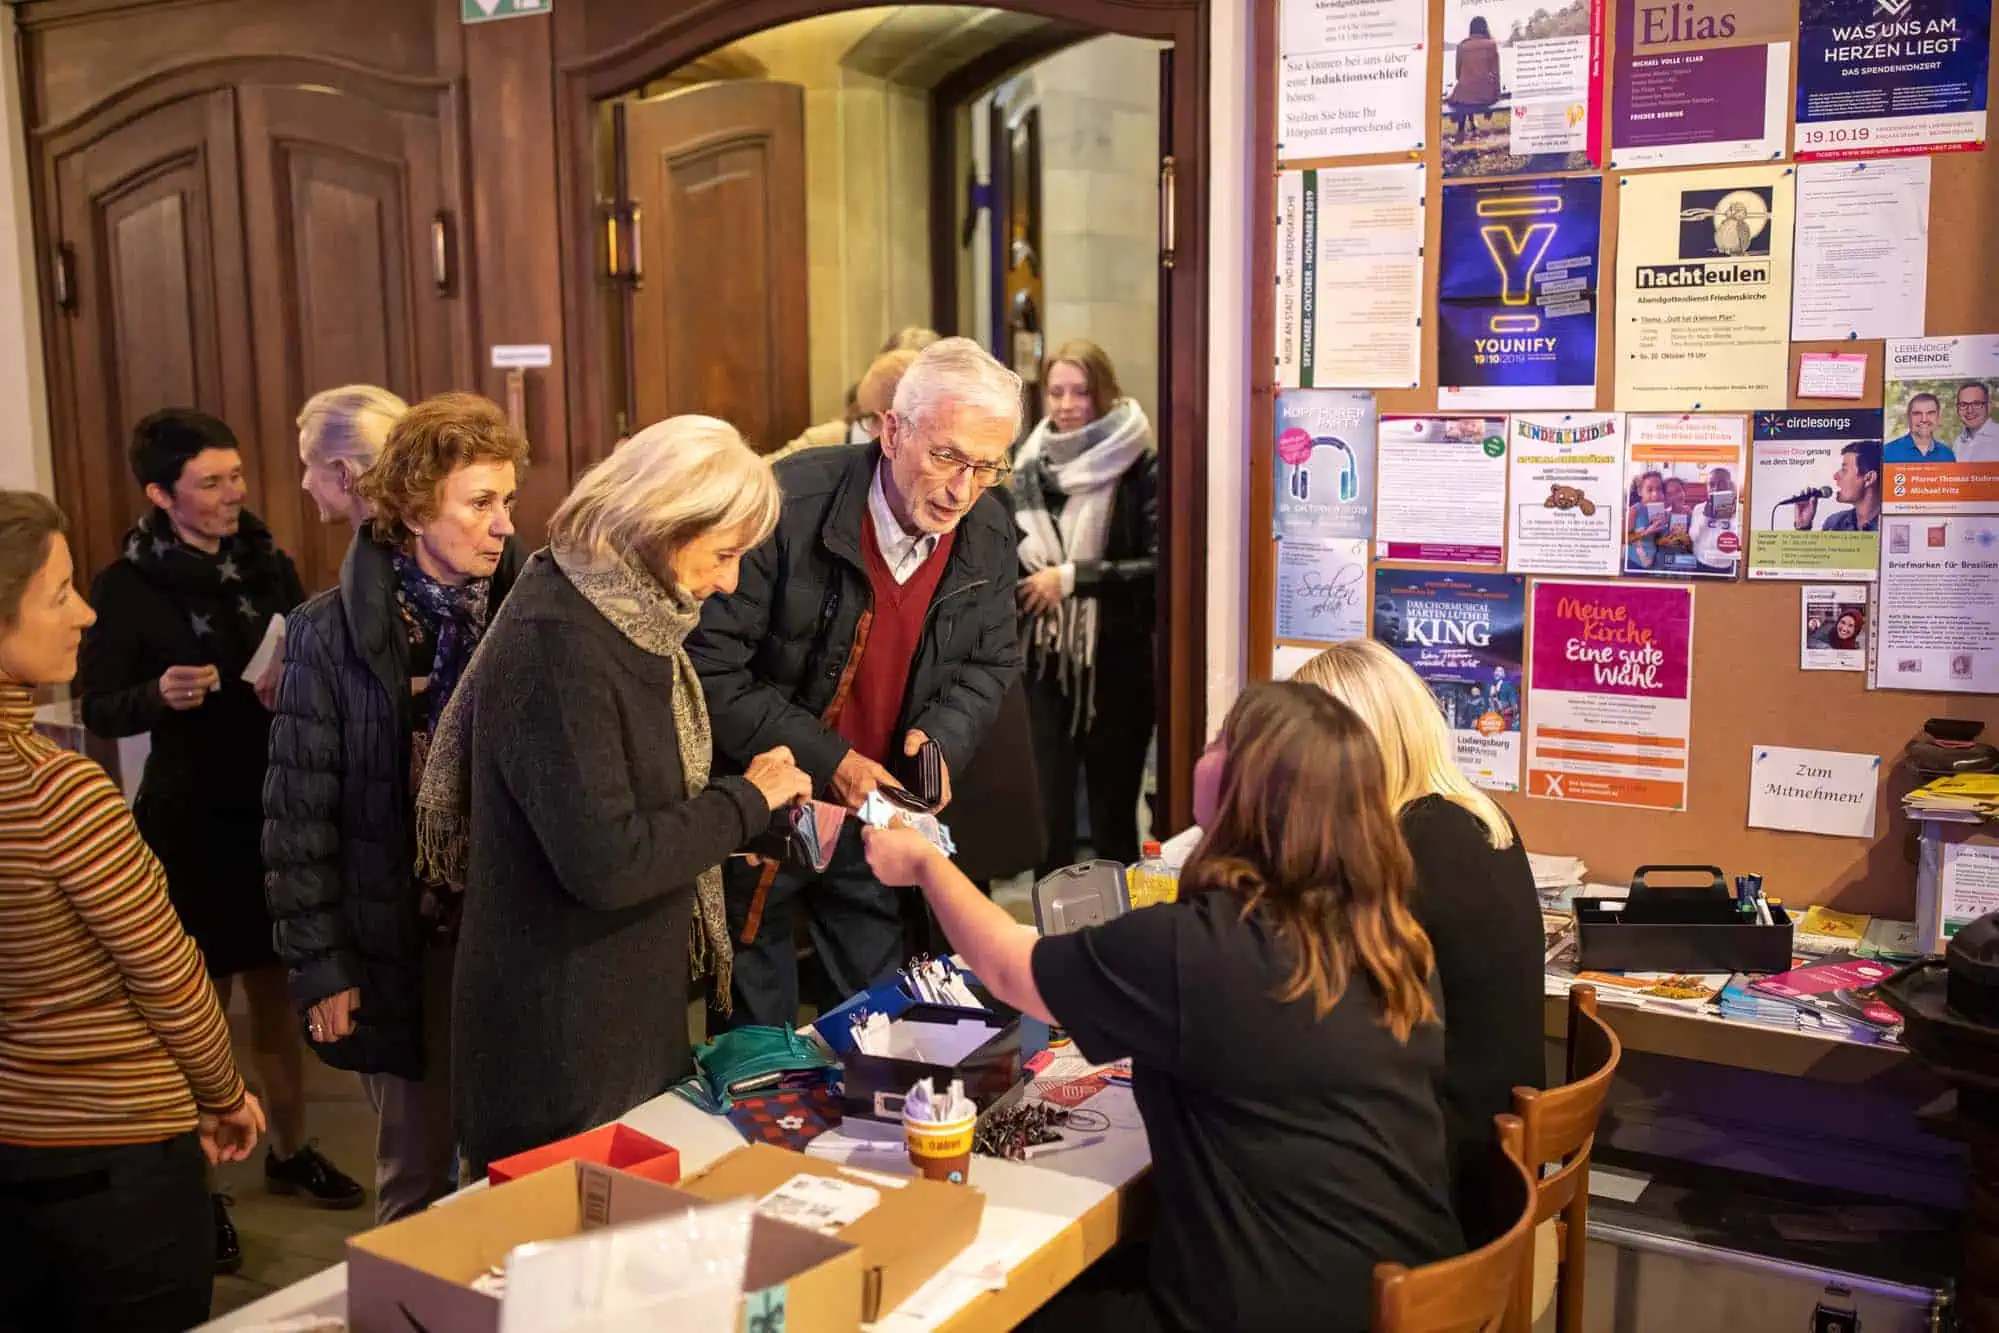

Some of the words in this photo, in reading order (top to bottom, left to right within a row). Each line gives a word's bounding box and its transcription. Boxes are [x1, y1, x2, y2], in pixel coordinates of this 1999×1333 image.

[1641, 3, 1736, 45] Elias
[1832, 24, 1876, 42] WAS
[1881, 21, 1921, 38] UNS
[1925, 17, 1956, 33] AM
[1824, 43, 1901, 63] HERZEN
[1905, 37, 1960, 56] LIEGT
[1311, 67, 1409, 86] Induktionsschleife
[1841, 67, 1860, 77] DAS
[1861, 61, 1942, 76] SPENDENKONZERT
[1805, 127, 1869, 144] 19.10.19
[1305, 213, 1314, 263] NOVEMBER
[1637, 265, 1767, 288] Nachteulen
[1304, 270, 1314, 312] OKTOBER
[1637, 294, 1709, 305] Abendgottesdienst
[1710, 292, 1767, 303] Friedenskirche
[1303, 318, 1313, 368] SEPTEMBER
[1474, 337, 1557, 353] YOUNIFY
[1894, 343, 1951, 353] LEBENDIGE
[1894, 353, 1950, 364] GEMEINDE
[1786, 416, 1851, 430] circlesongs
[1888, 560, 1941, 570] Briefmarken
[1944, 560, 1958, 569] für
[1961, 560, 1999, 569] Brasilien
[1406, 599, 1424, 609] DAS
[1424, 600, 1489, 612] CHORMUSICAL
[1406, 608, 1446, 619] MARTIN
[1448, 610, 1489, 620] LUTHER
[1556, 597, 1628, 622] Meine
[1405, 617, 1492, 647] KING
[1565, 638, 1614, 663] Eine
[1618, 642, 1665, 672] gute
[1594, 664, 1664, 689] Wahl.
[1457, 735, 1510, 749] Ludwigsburg
[1796, 763, 1832, 779] Zum
[1764, 783, 1864, 804] Mitnehmen!
